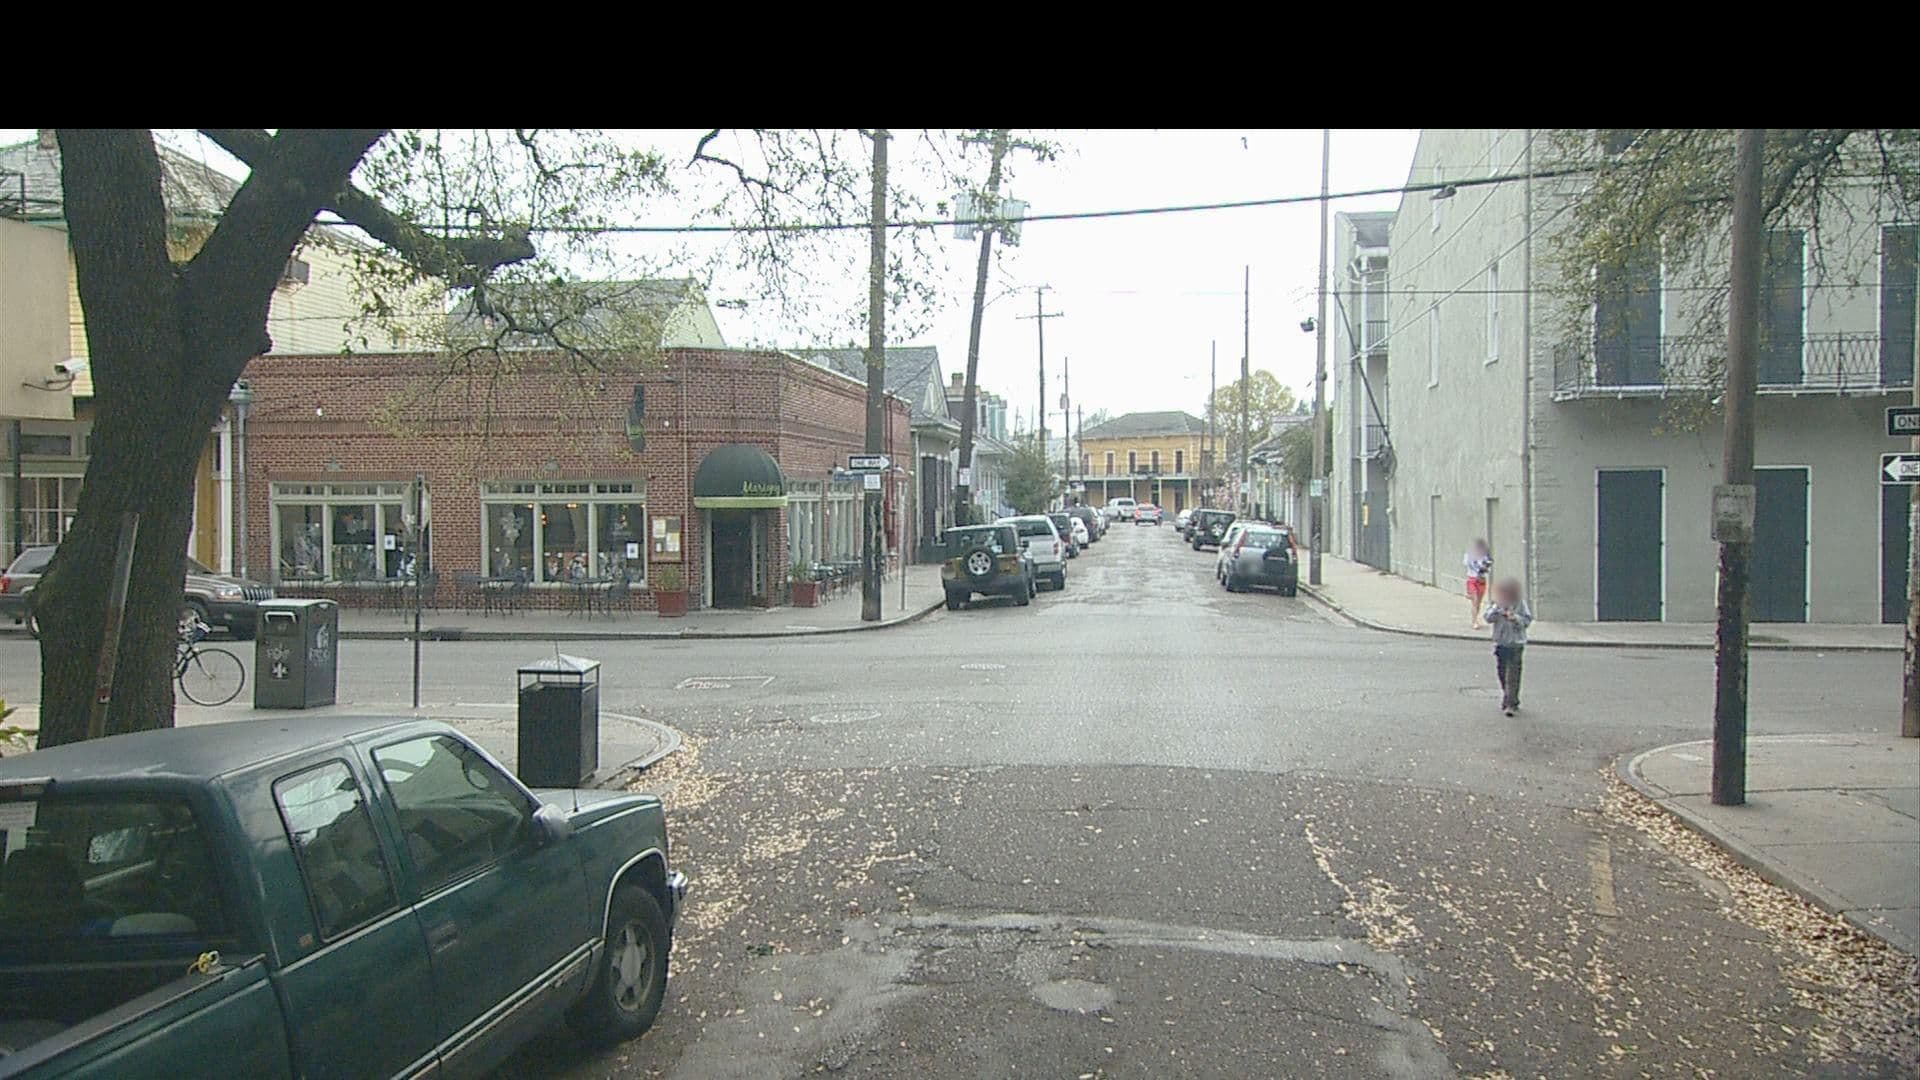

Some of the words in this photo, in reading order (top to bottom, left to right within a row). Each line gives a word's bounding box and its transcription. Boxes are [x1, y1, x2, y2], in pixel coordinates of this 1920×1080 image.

[853, 459, 865, 467] ONE
[867, 459, 880, 467] WAY
[1901, 463, 1919, 473] ONE
